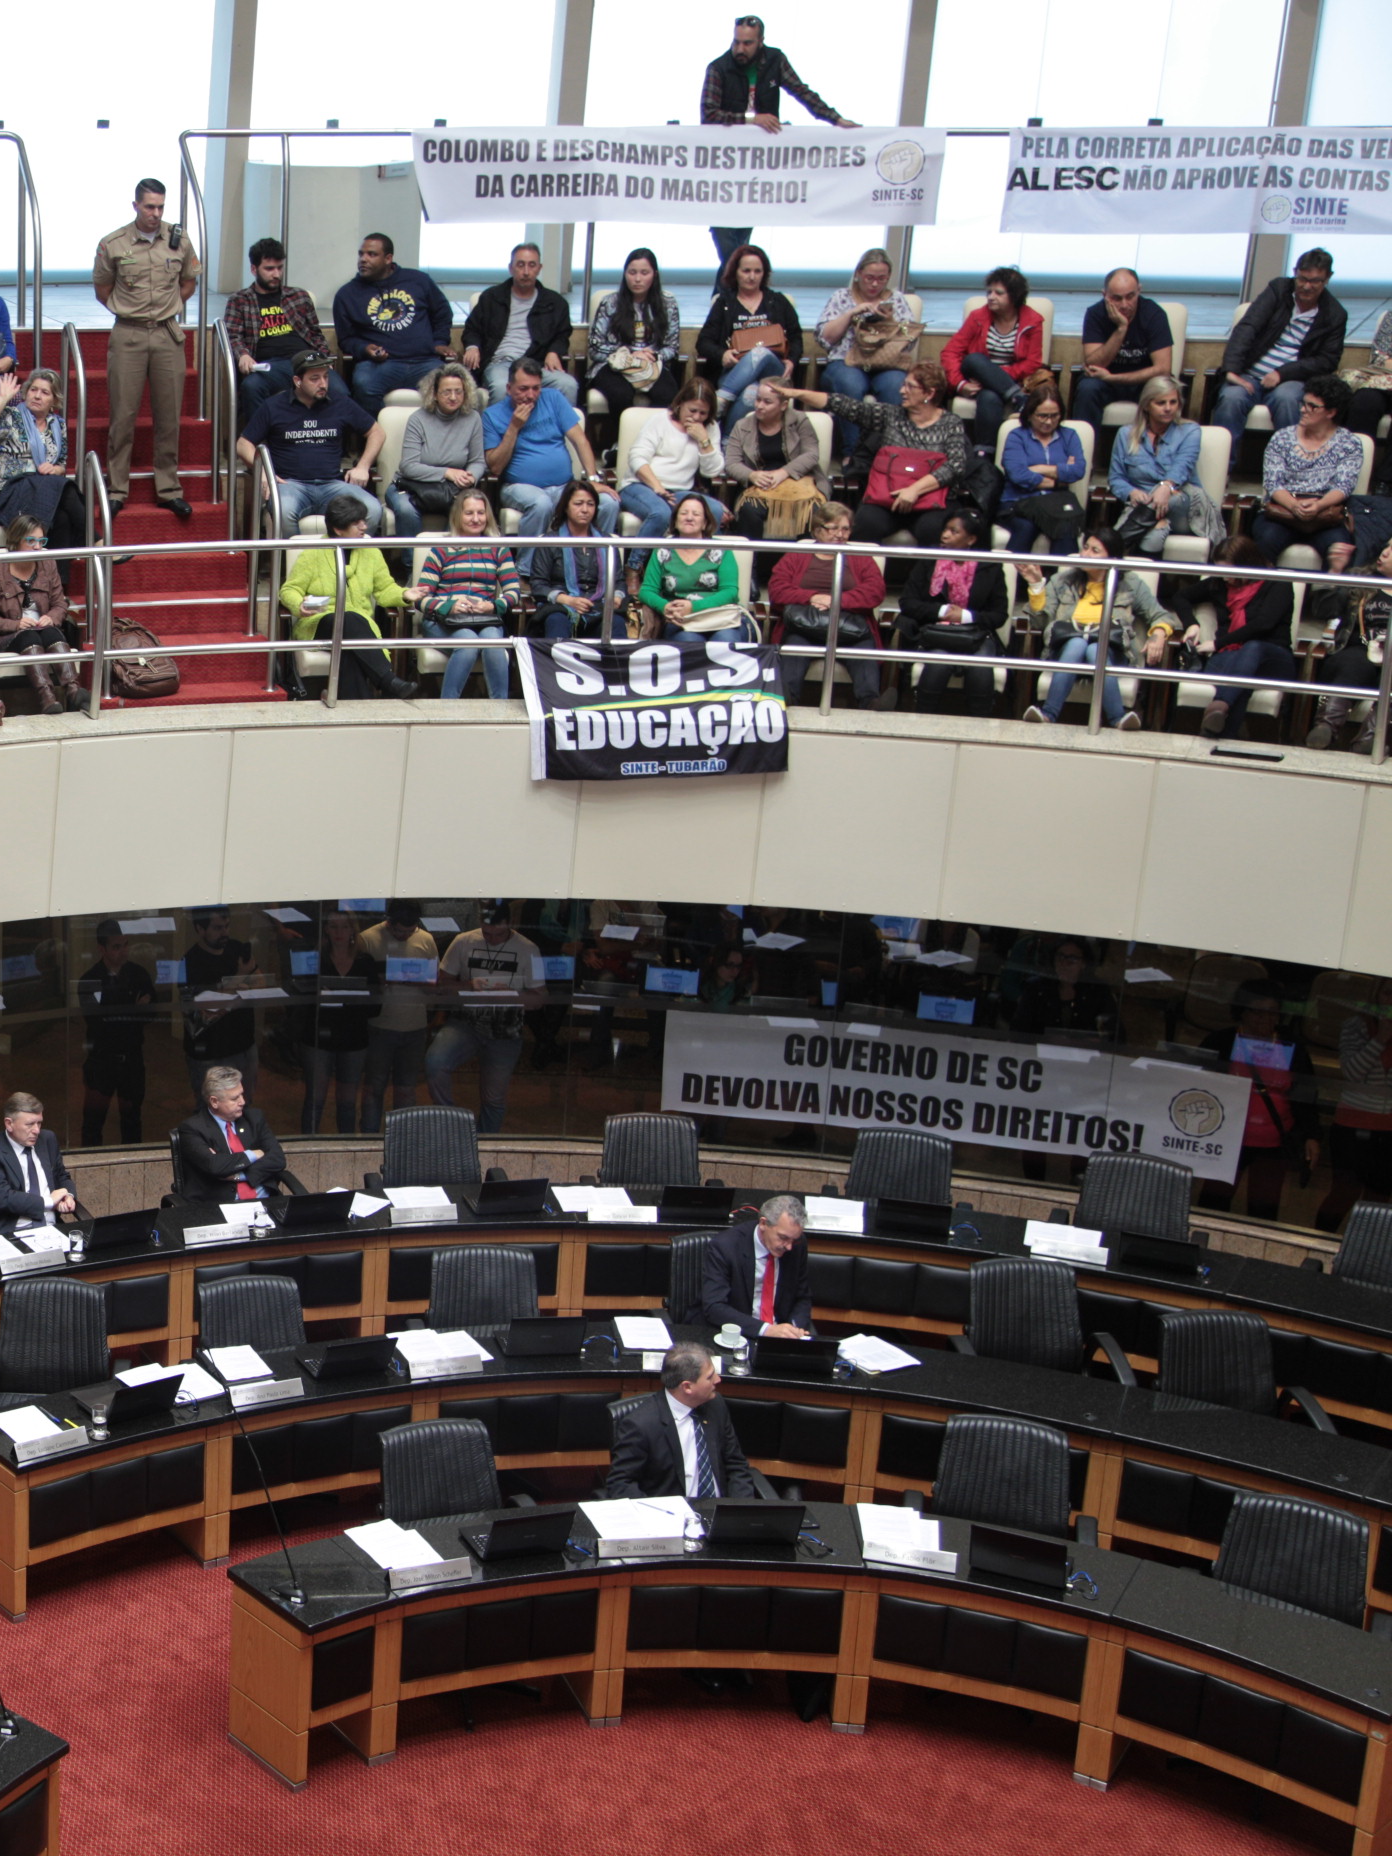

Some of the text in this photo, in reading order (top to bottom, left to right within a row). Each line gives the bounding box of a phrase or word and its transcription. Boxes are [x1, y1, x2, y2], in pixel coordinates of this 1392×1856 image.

[422, 137, 867, 170] COLOMBO E DESCHAMPS DESTRUIDORES
[1021, 136, 1069, 159] PELA
[1074, 137, 1171, 159] CORRETA
[1176, 133, 1303, 161] APLICAÇÃO
[1307, 138, 1353, 159] DAS
[474, 172, 808, 205] DA CARREIRA DO MAGISTÉRIO!
[1007, 164, 1391, 192] ALESC NÃO APROVE AS CONTAS
[872, 188, 925, 202] SINTE-SC
[1293, 197, 1350, 217] SINTE
[1290, 216, 1347, 225] Santa Catarina
[285, 429, 338, 440] INDEPENDENTE
[303, 420, 318, 429] SOU
[551, 641, 776, 697] S.O.S.
[552, 692, 785, 756] EDUCAÇÃO
[620, 760, 659, 776] SINTE
[667, 757, 727, 774] TUBARÃO
[783, 1033, 1044, 1094] GOVERNO DE SC
[681, 1072, 1145, 1154] DEVOLVA NOSSOS DIREITOS!
[1161, 1135, 1224, 1157] SINTE-SC
[616, 1545, 631, 1553] Dep.
[651, 1543, 666, 1551] Silva
[884, 1551, 898, 1560] Dep.
[399, 1578, 412, 1586] Dep.
